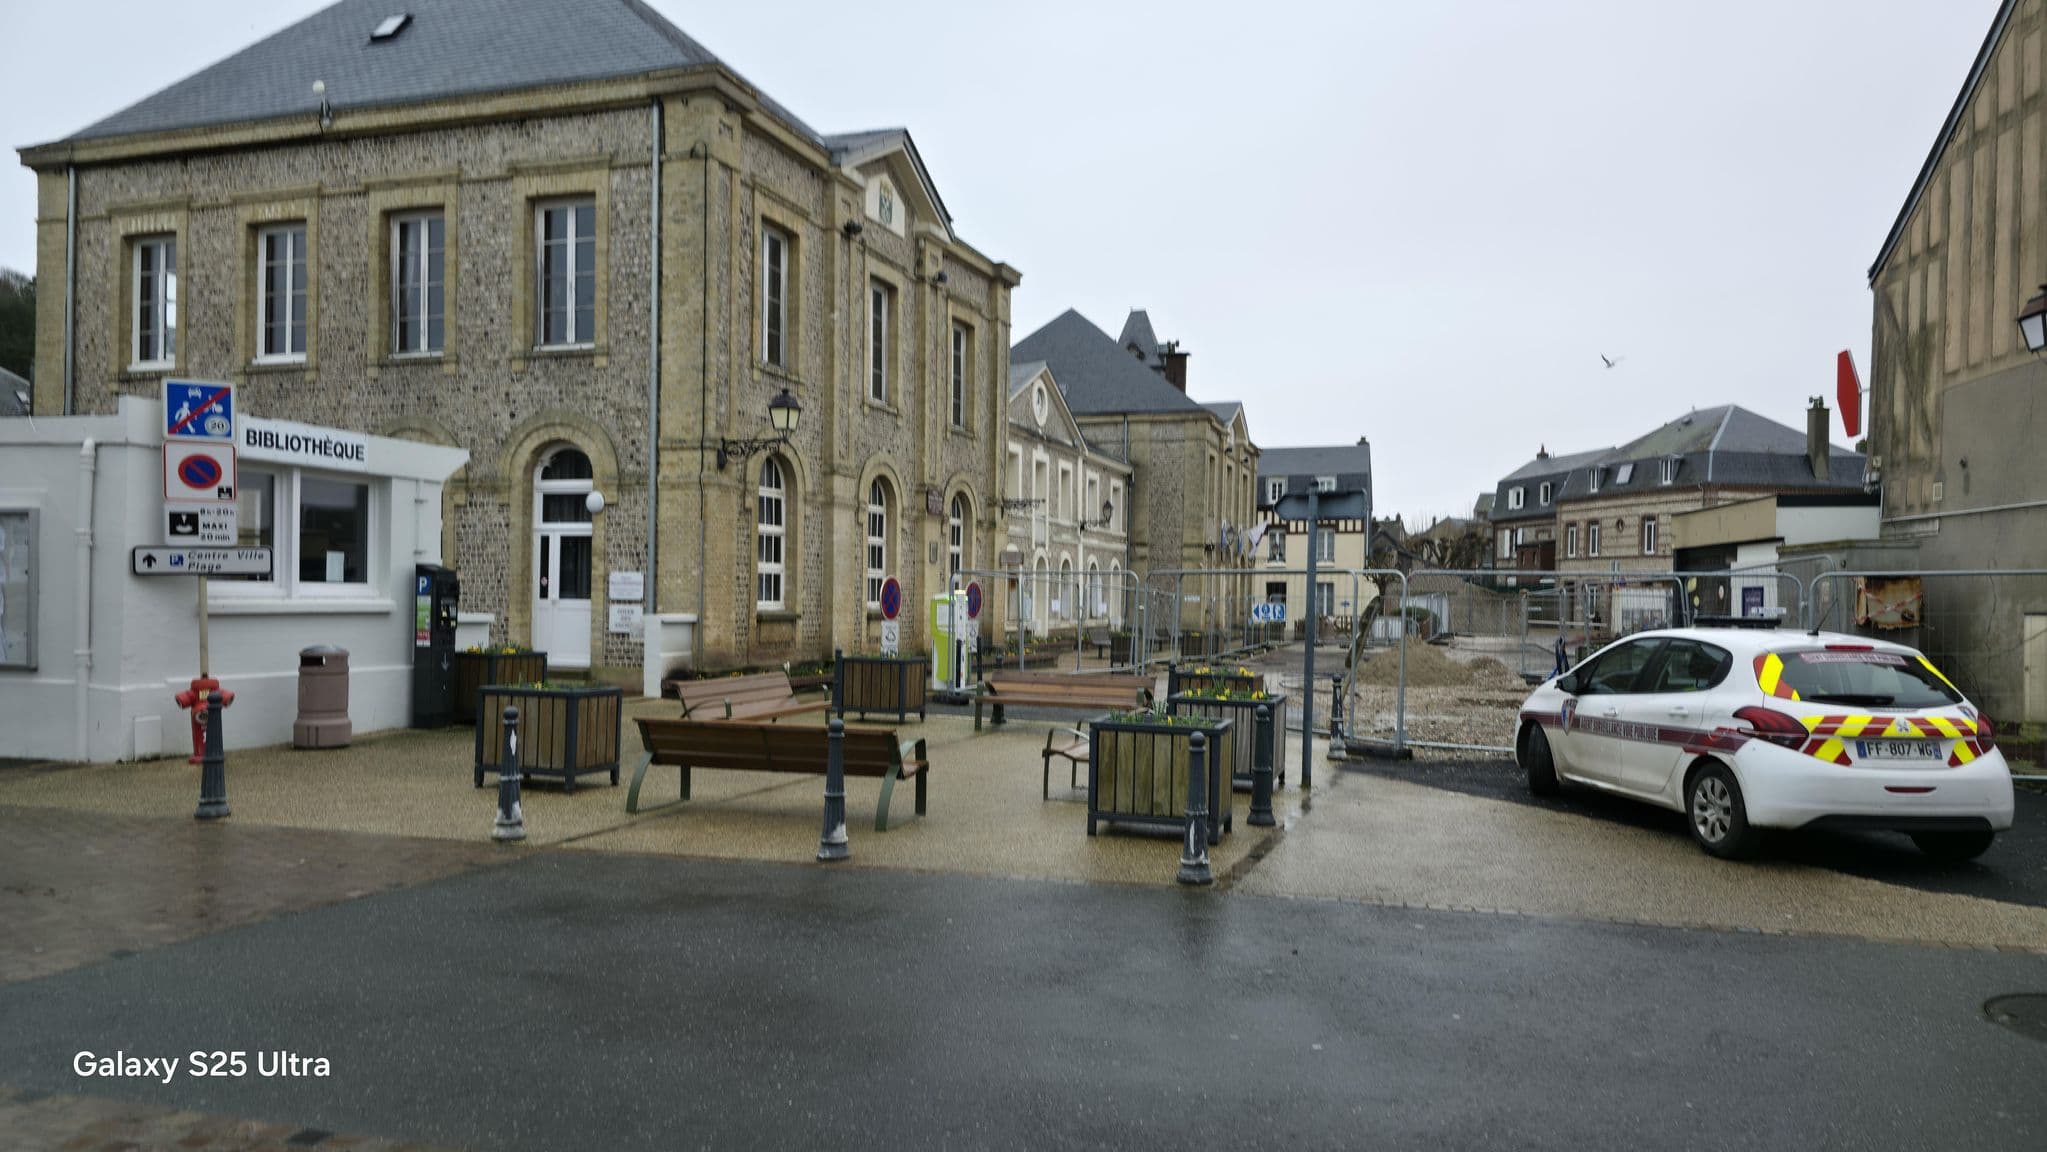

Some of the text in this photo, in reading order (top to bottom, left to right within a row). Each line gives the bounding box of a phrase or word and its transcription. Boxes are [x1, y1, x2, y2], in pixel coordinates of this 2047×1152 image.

[245, 428, 365, 462] BIBLIOTHÈQUE
[202, 522, 228, 531] MAXI
[188, 551, 264, 560] Centre Ville
[188, 562, 222, 573] Plage
[419, 576, 428, 593] P
